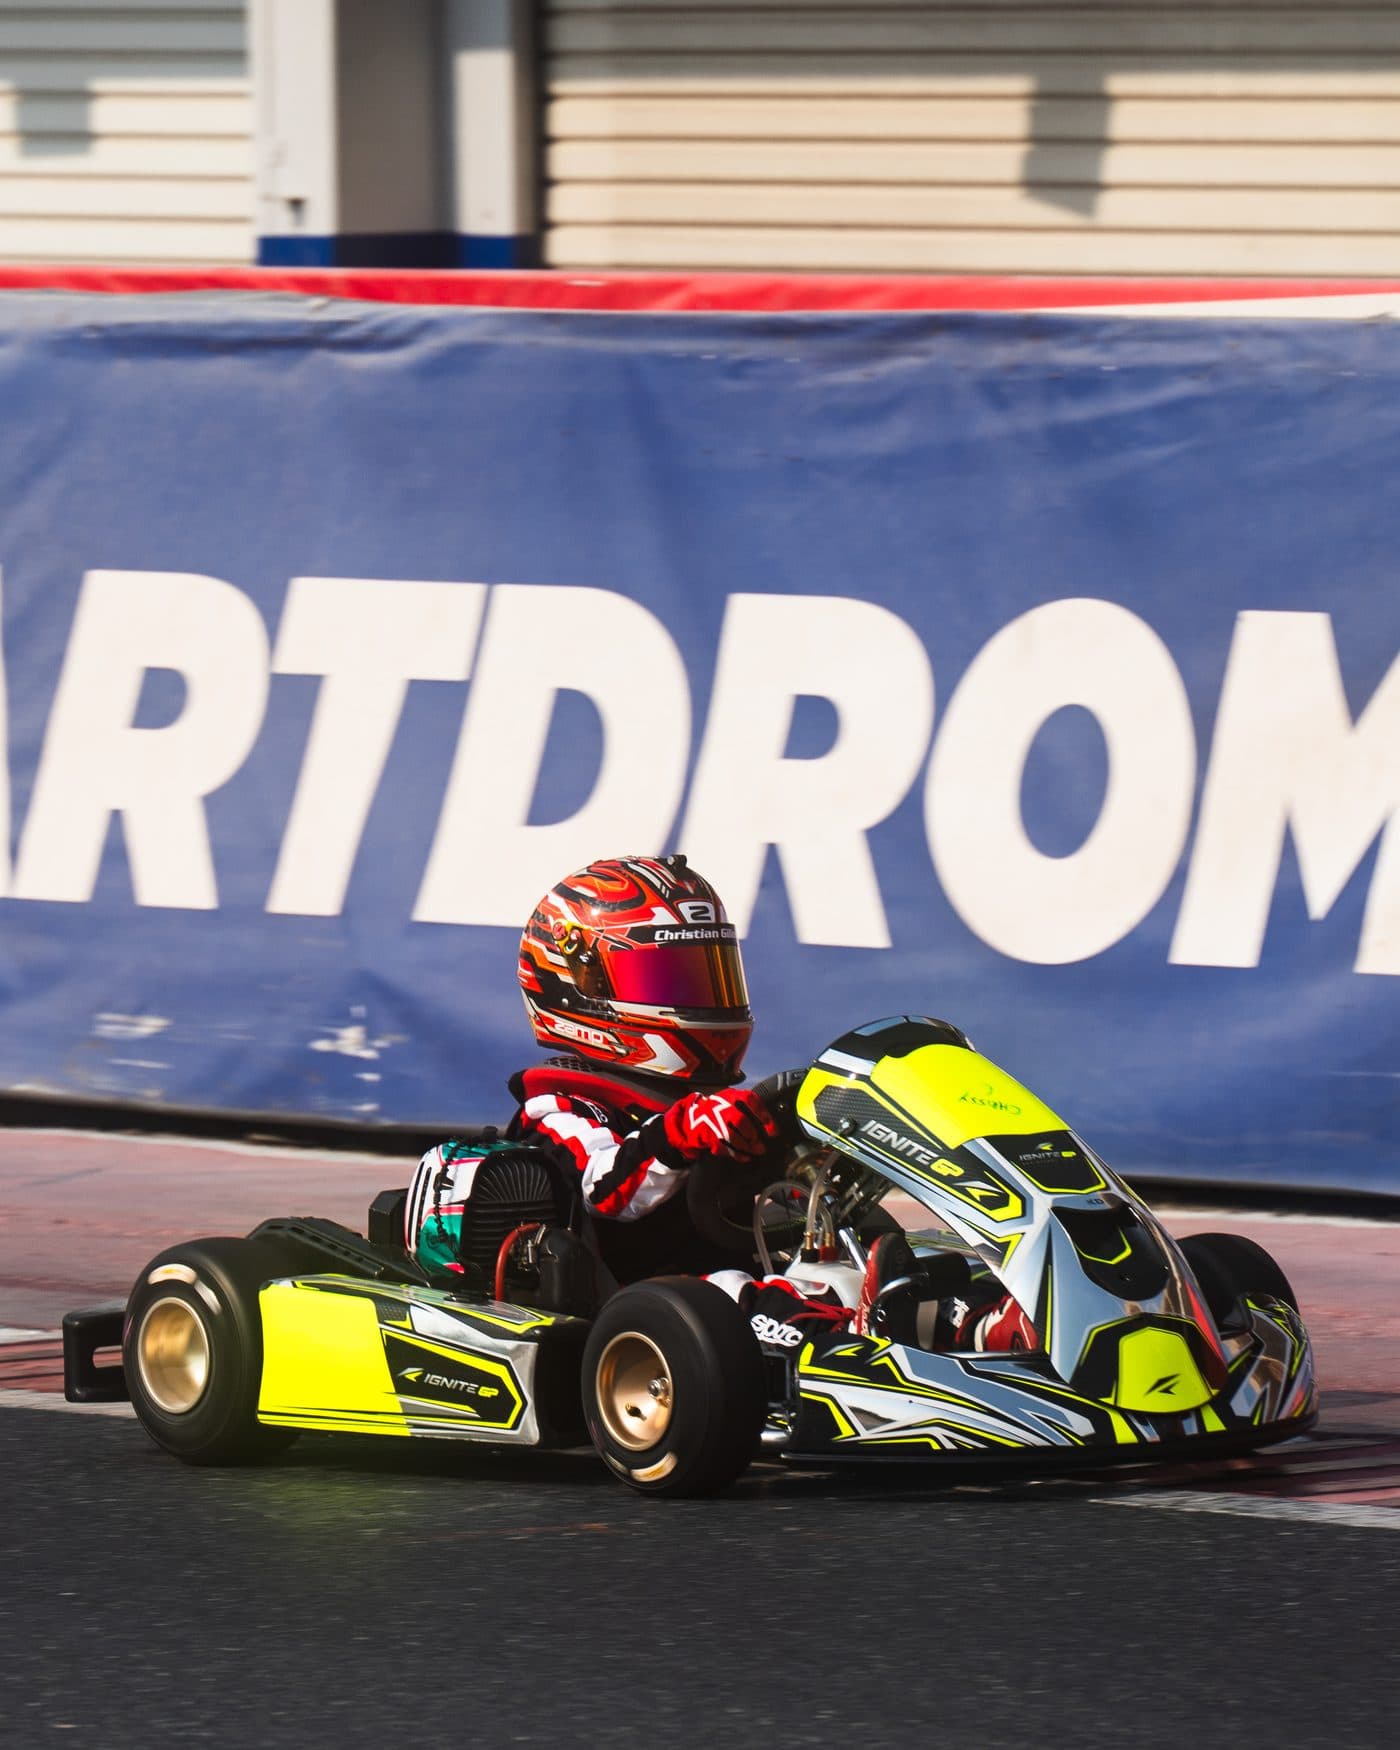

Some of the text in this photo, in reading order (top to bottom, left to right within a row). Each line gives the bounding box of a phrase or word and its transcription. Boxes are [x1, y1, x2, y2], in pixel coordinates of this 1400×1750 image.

[0, 568, 1400, 975] RTDROM
[688, 905, 713, 921] 2
[654, 928, 719, 941] Christian
